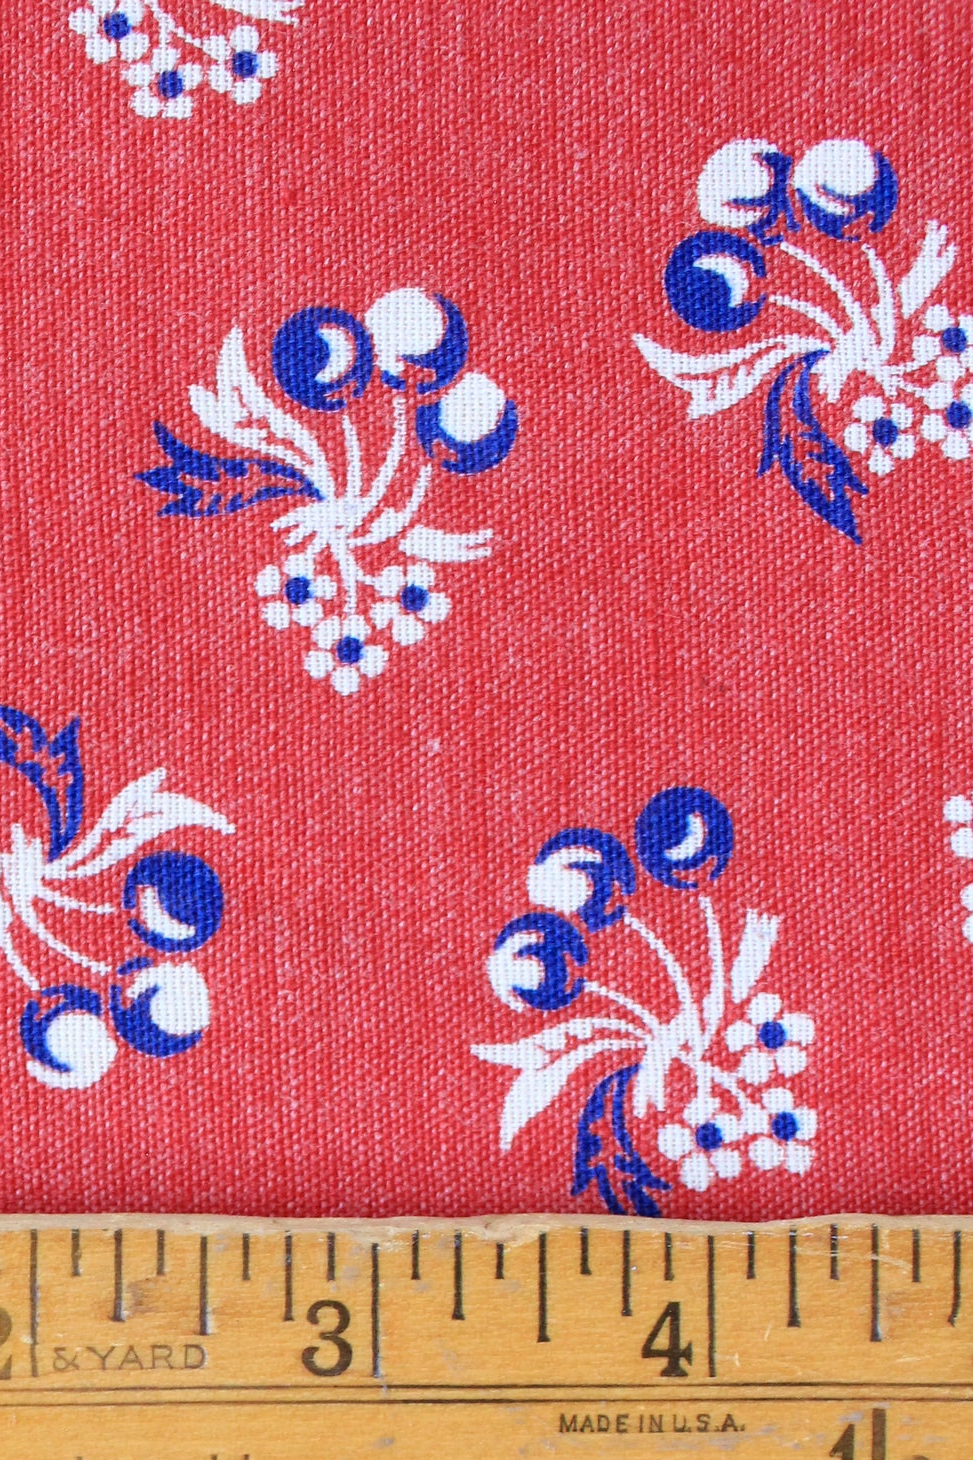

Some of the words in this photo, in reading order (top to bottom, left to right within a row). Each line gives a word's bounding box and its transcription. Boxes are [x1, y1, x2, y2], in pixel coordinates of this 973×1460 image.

[301, 1300, 353, 1377] 3
[640, 1301, 693, 1378] 4
[558, 1412, 629, 1434] MADE
[638, 1413, 666, 1434] IN
[672, 1412, 747, 1434] U.S.A.
